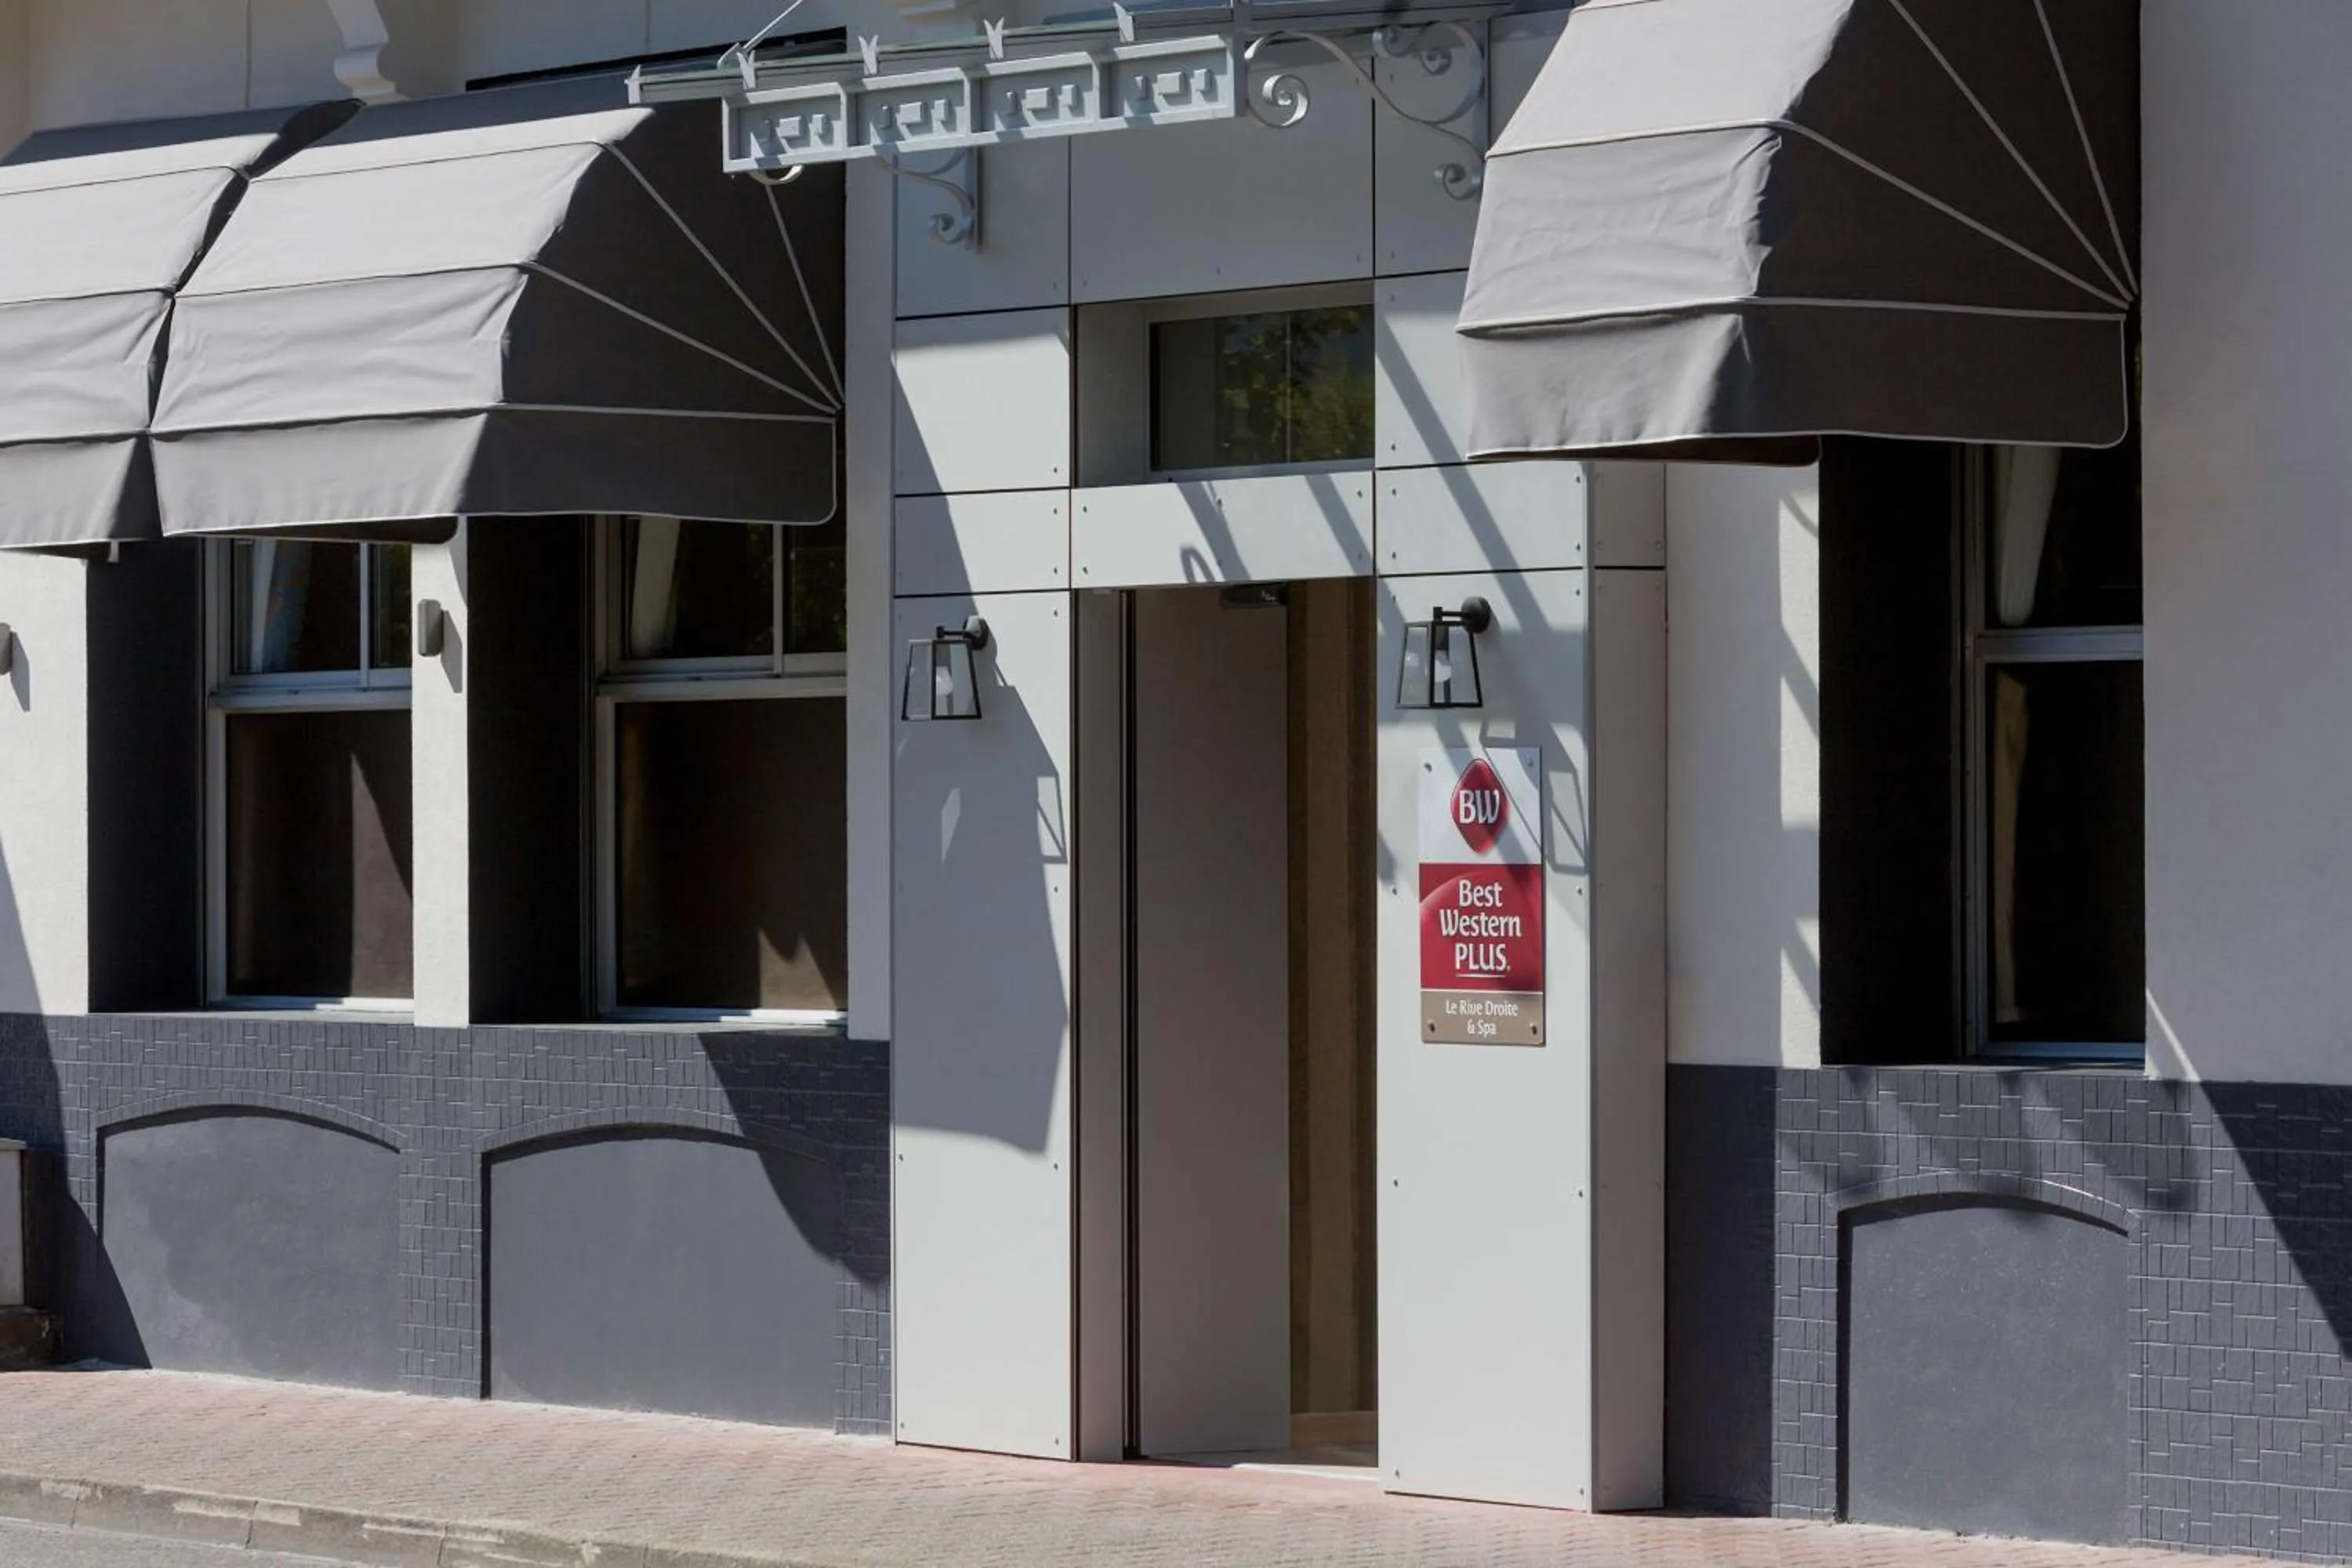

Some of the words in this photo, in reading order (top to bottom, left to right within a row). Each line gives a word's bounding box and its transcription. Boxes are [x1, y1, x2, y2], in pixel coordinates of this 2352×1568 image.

[1459, 788, 1500, 824] BW
[1459, 879, 1503, 908] Best
[1439, 909, 1522, 938] Western
[1445, 1000, 1457, 1015] Le
[1460, 1000, 1483, 1016] Rive
[1485, 1000, 1519, 1017] Droite
[1477, 1018, 1497, 1039] Spa
